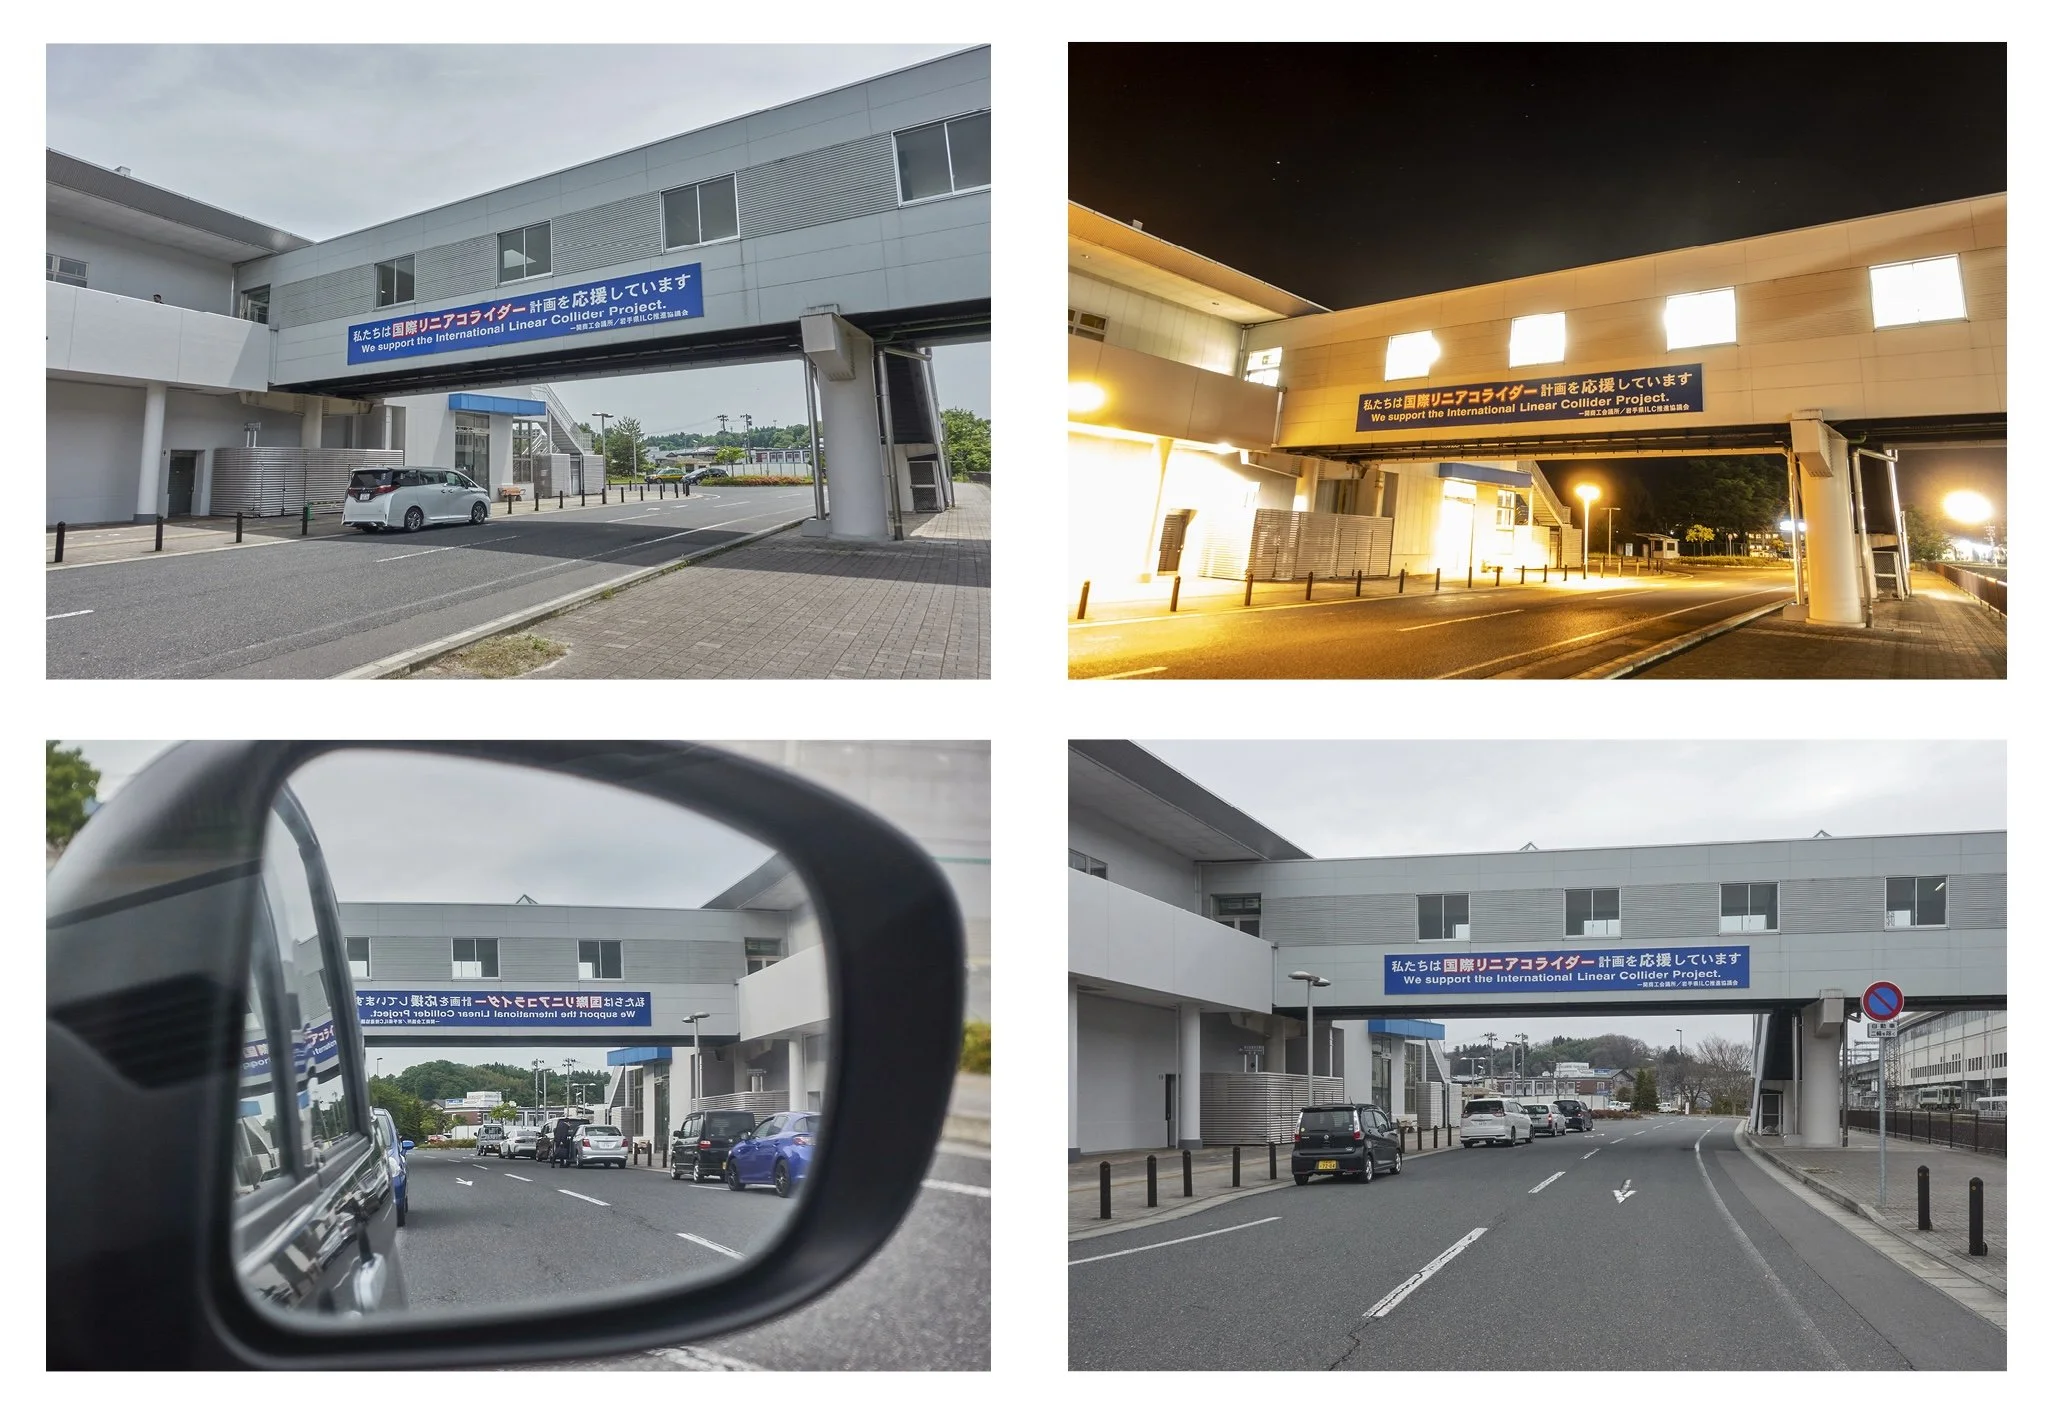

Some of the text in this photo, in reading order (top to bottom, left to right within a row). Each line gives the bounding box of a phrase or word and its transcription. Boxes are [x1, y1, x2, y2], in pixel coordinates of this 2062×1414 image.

[362, 299, 666, 353] We support the International Linear Collider Project.
[1371, 392, 1670, 422] We support the International Linear Collider Project.
[1403, 970, 1721, 986] We support the International Linear Collider Project.
